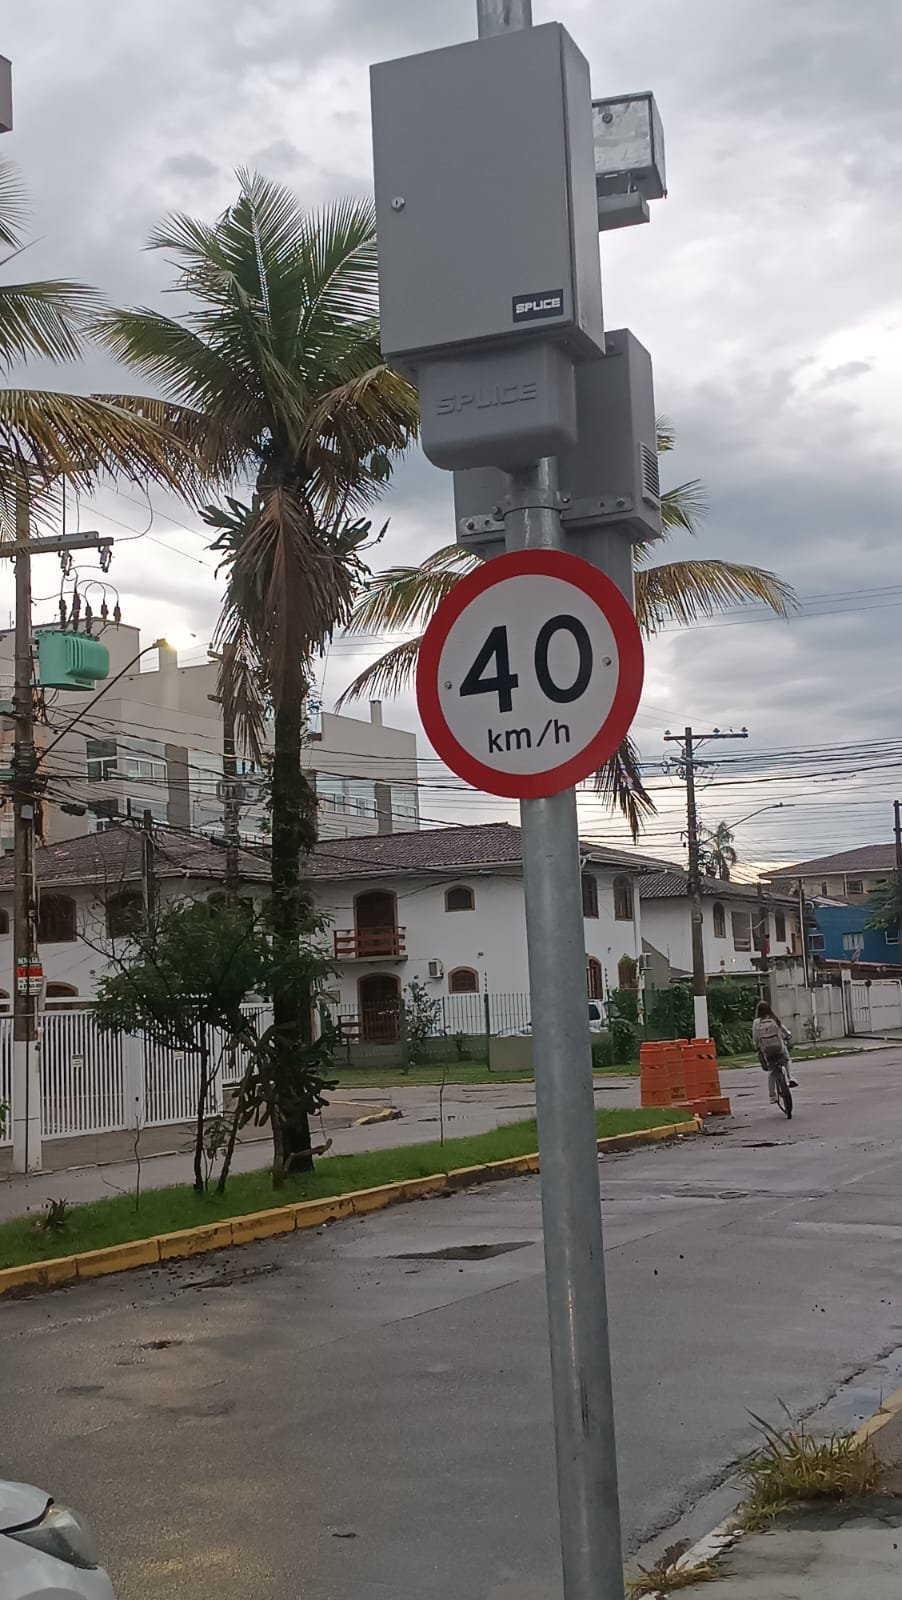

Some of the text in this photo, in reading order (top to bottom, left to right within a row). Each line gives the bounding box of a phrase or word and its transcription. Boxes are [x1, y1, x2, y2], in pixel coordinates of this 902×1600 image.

[515, 297, 561, 314] SPLICE
[435, 381, 537, 416] SPLICE
[459, 614, 593, 714] 40
[488, 719, 571, 754] km/h
